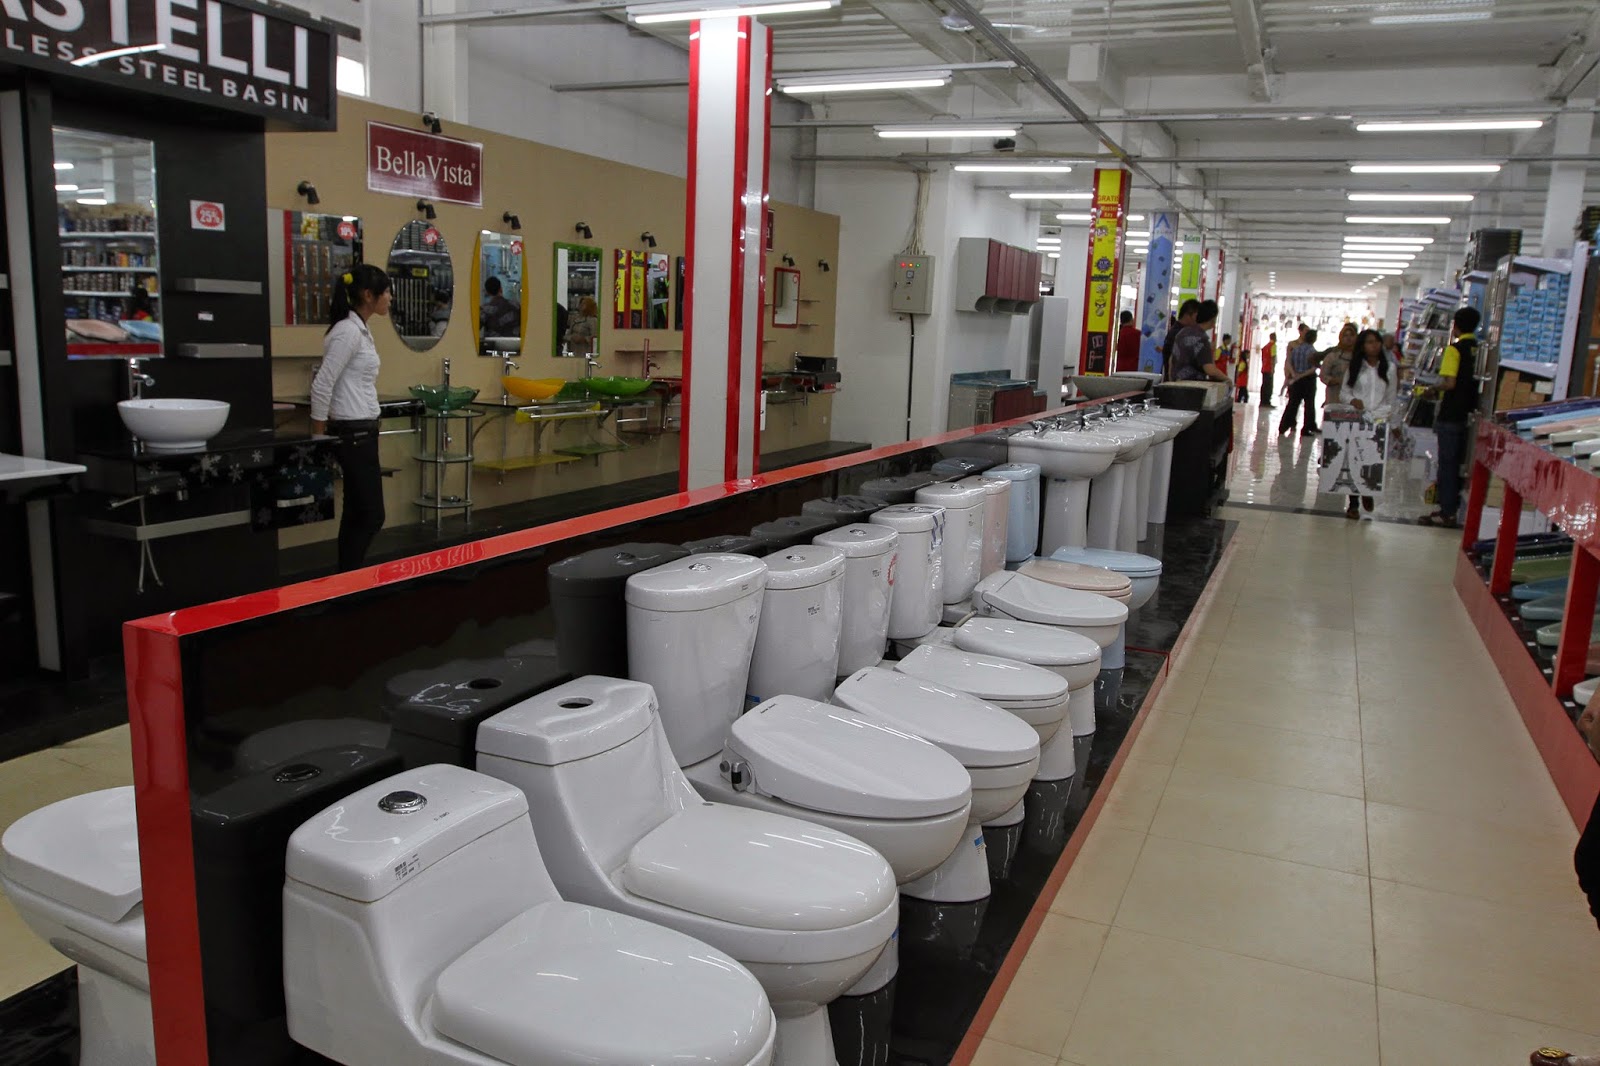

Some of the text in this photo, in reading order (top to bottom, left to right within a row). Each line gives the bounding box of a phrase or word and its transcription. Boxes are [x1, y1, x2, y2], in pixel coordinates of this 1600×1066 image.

[0, 0, 308, 89] ELLI
[119, 56, 211, 92] STEEL
[222, 79, 308, 114] BASIN
[375, 145, 473, 186] BellaVista
[200, 209, 220, 223] 25%
